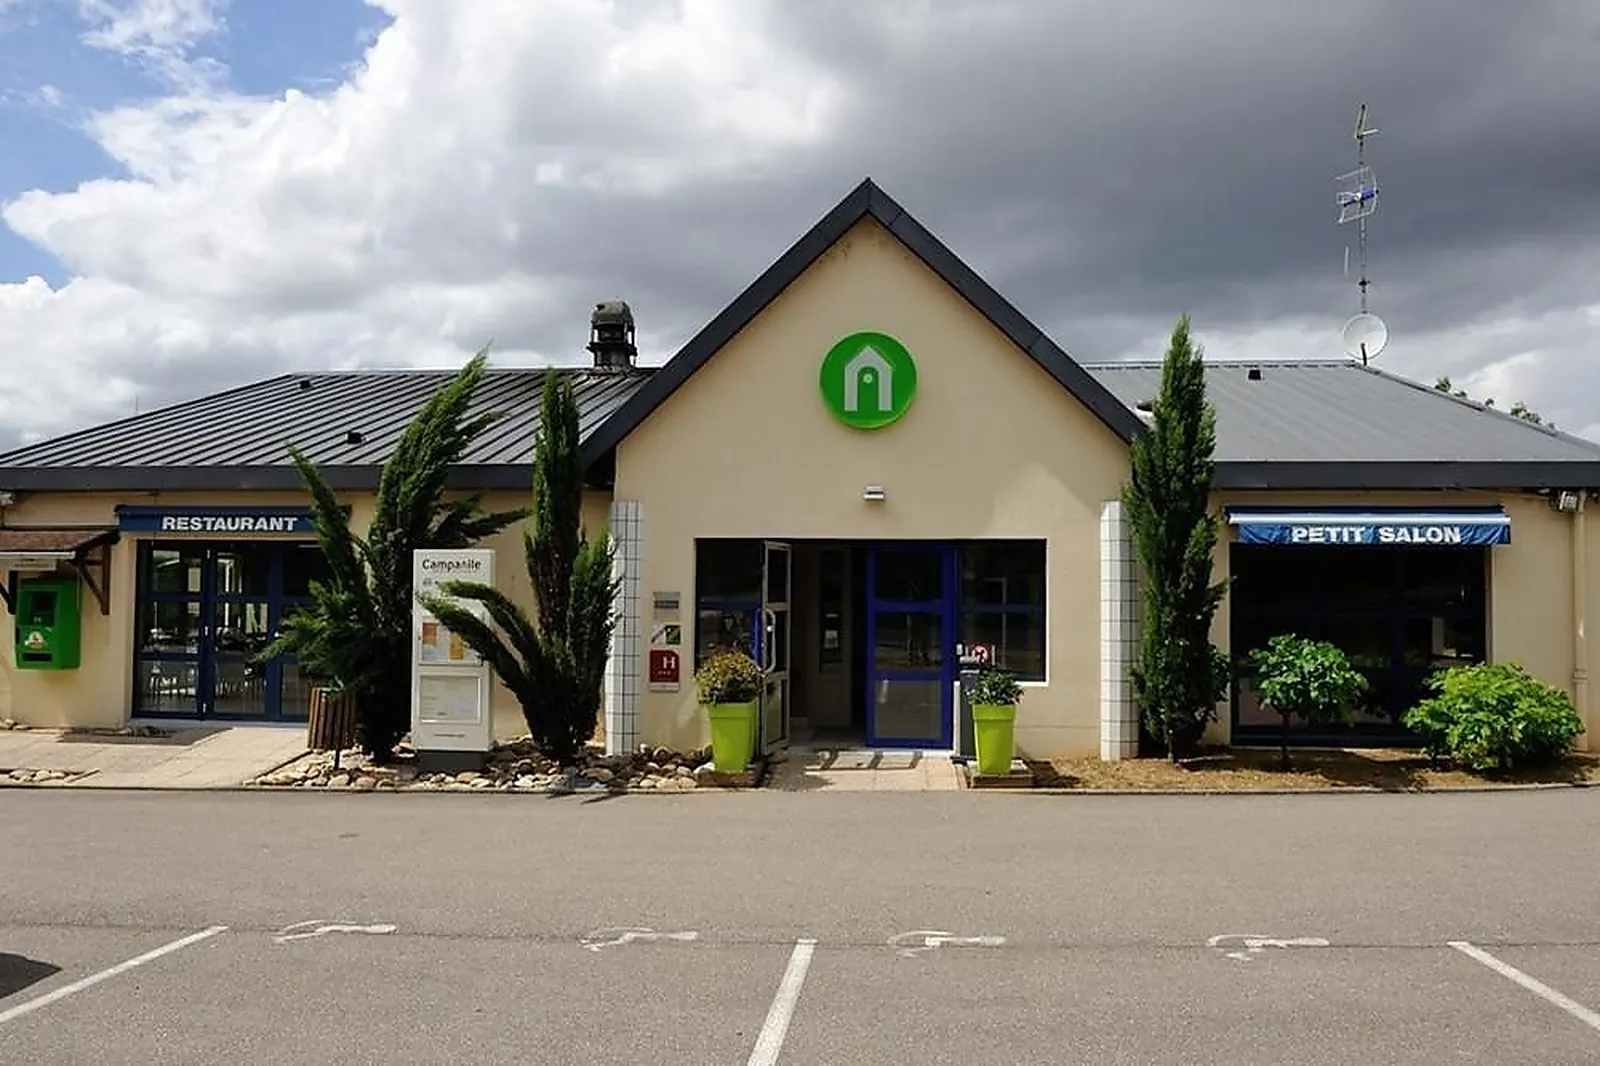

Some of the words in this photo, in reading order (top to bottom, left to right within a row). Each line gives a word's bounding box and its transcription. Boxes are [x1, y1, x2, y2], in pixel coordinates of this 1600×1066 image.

[162, 516, 297, 531] RESTAURANT
[1292, 526, 1366, 543] PETIT
[1379, 526, 1461, 543] SALON
[422, 558, 481, 573] Campanile
[663, 656, 676, 669] H
